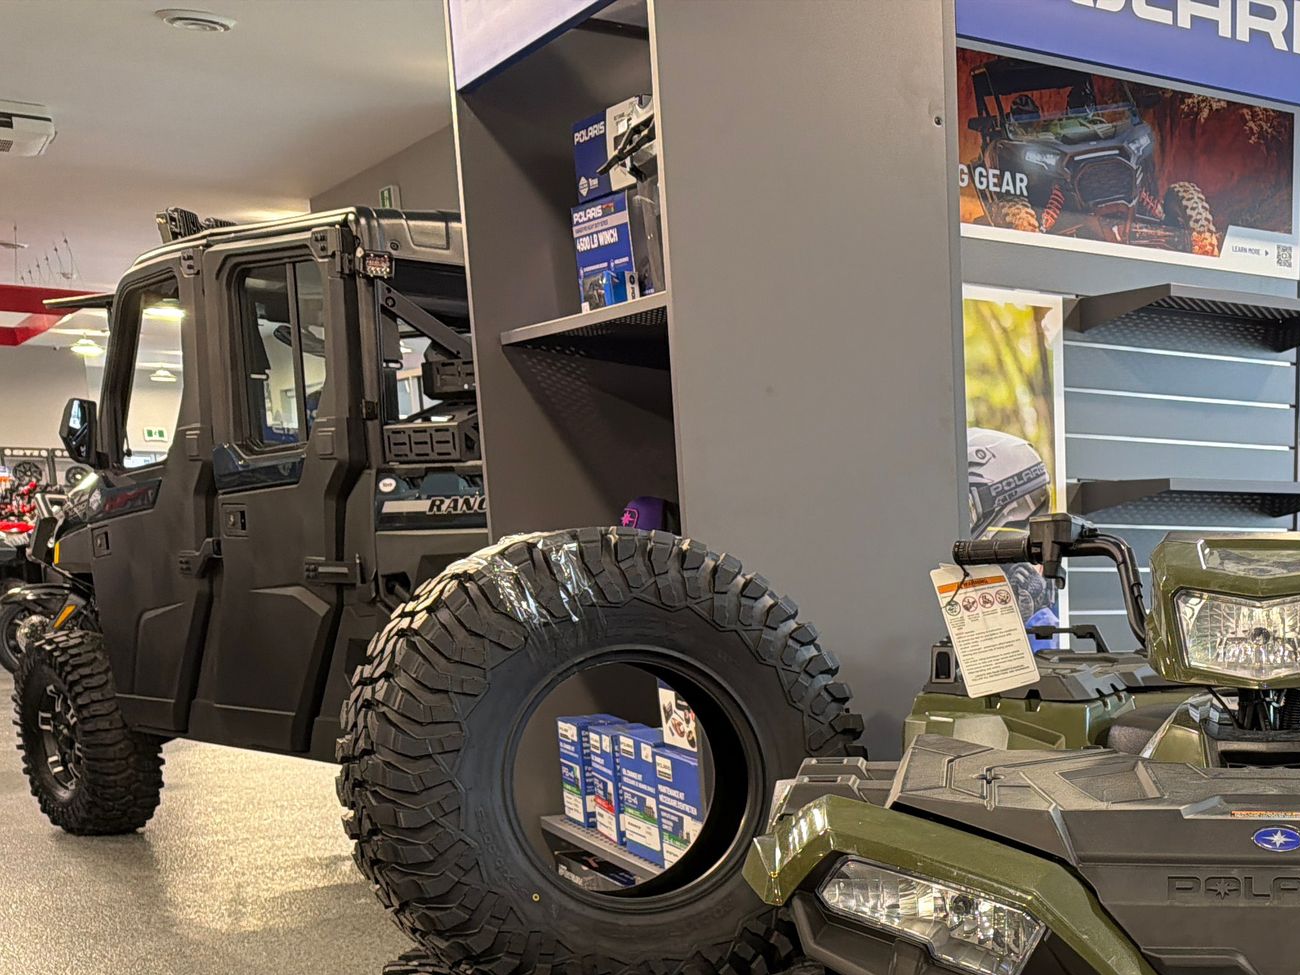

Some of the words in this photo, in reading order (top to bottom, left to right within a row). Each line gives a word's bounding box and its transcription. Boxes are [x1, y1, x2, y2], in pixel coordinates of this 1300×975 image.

[574, 121, 605, 145] POLARIS
[974, 166, 1028, 196] GEAR
[573, 205, 602, 225] POLARIS
[591, 234, 599, 249] LB
[598, 227, 619, 246] WINCH
[1232, 245, 1248, 253] LEARN
[1248, 247, 1260, 256] MORE
